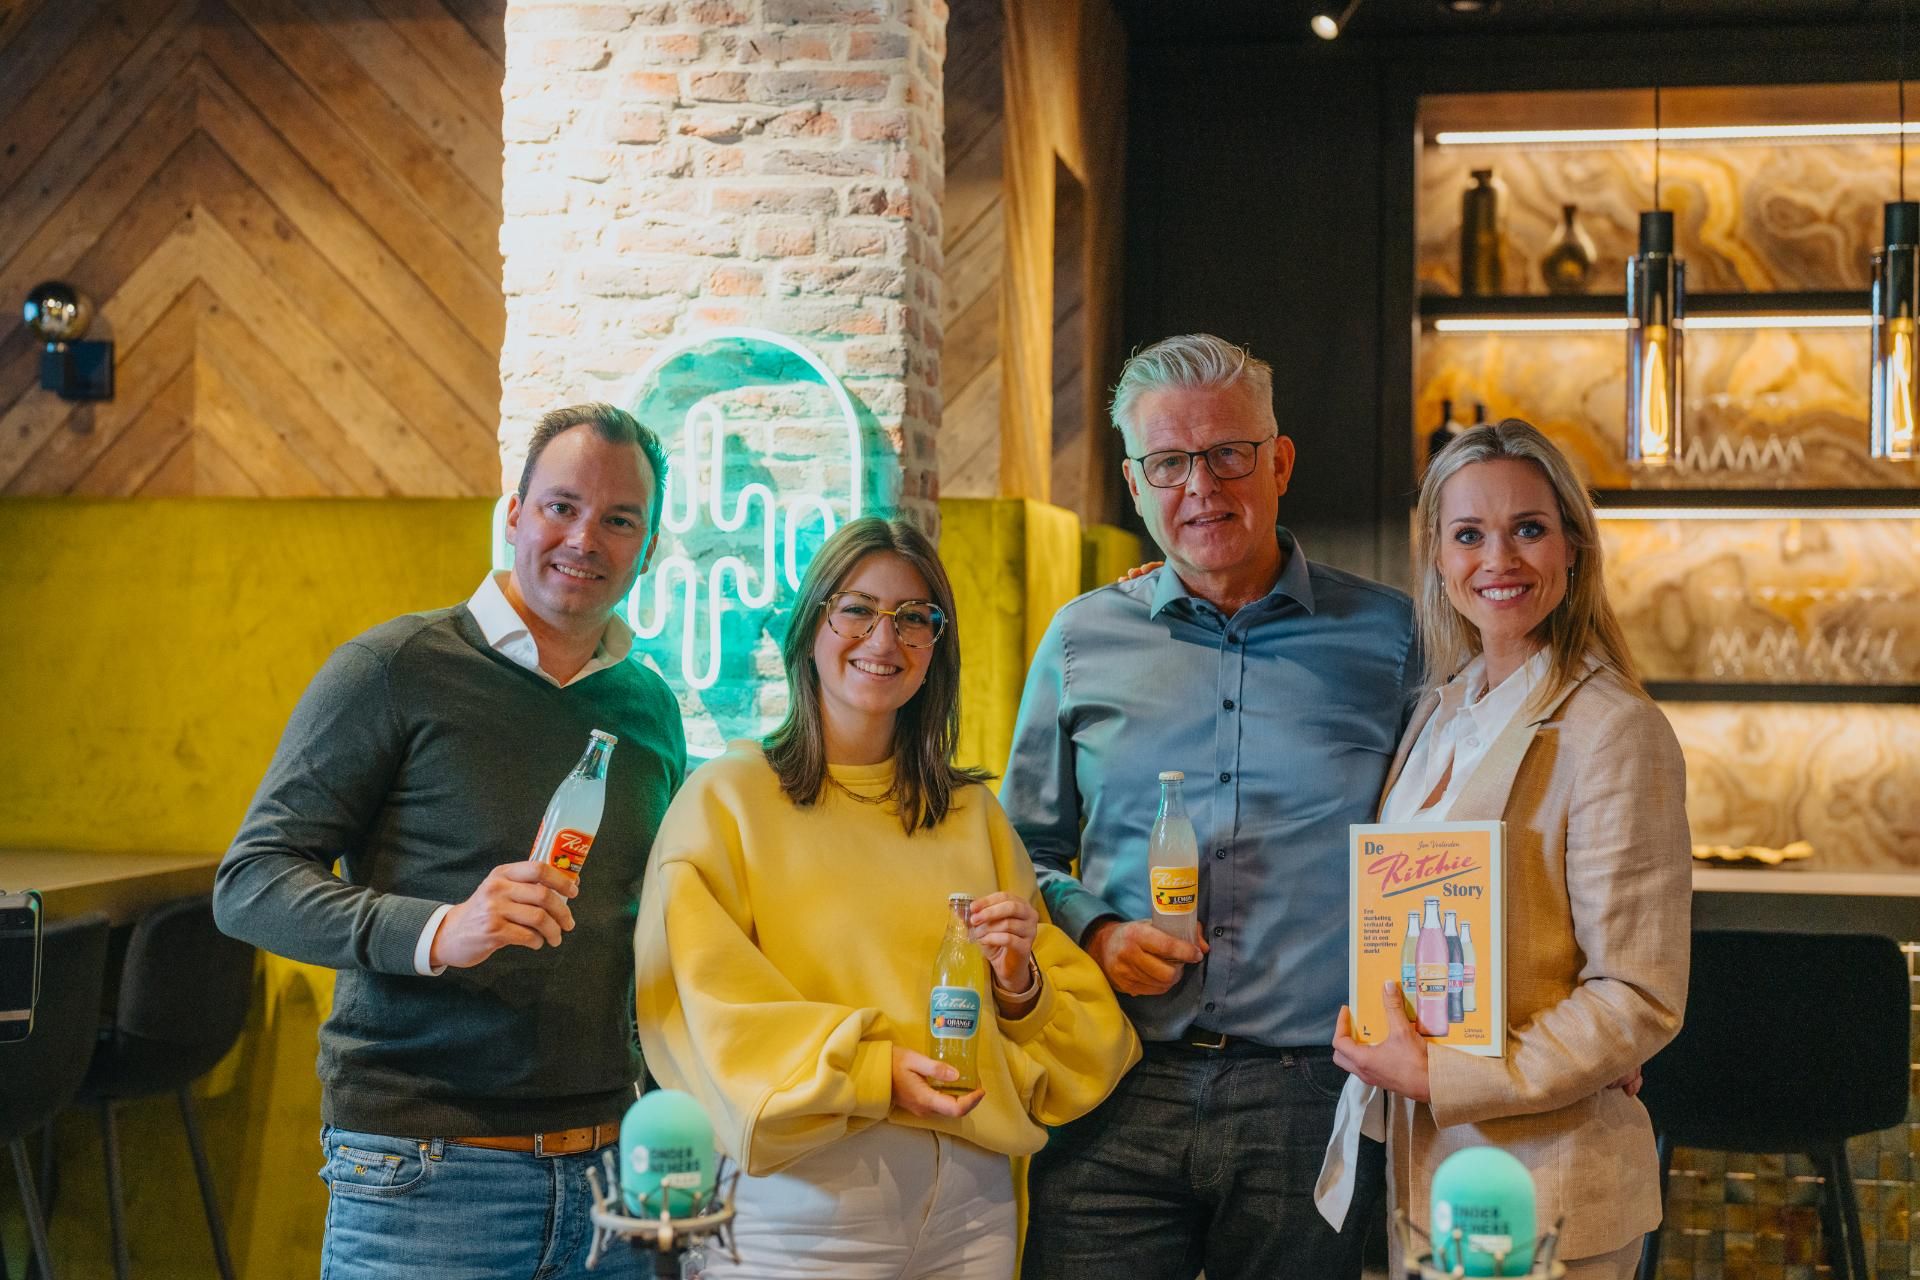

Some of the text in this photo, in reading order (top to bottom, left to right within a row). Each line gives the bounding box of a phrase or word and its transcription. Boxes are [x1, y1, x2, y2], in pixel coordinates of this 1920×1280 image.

[1364, 841, 1385, 855] De
[1367, 850, 1478, 892] Ritchie
[1442, 882, 1485, 900] Story
[932, 992, 976, 1009] Ritchie
[947, 1018, 972, 1027] ORANGE
